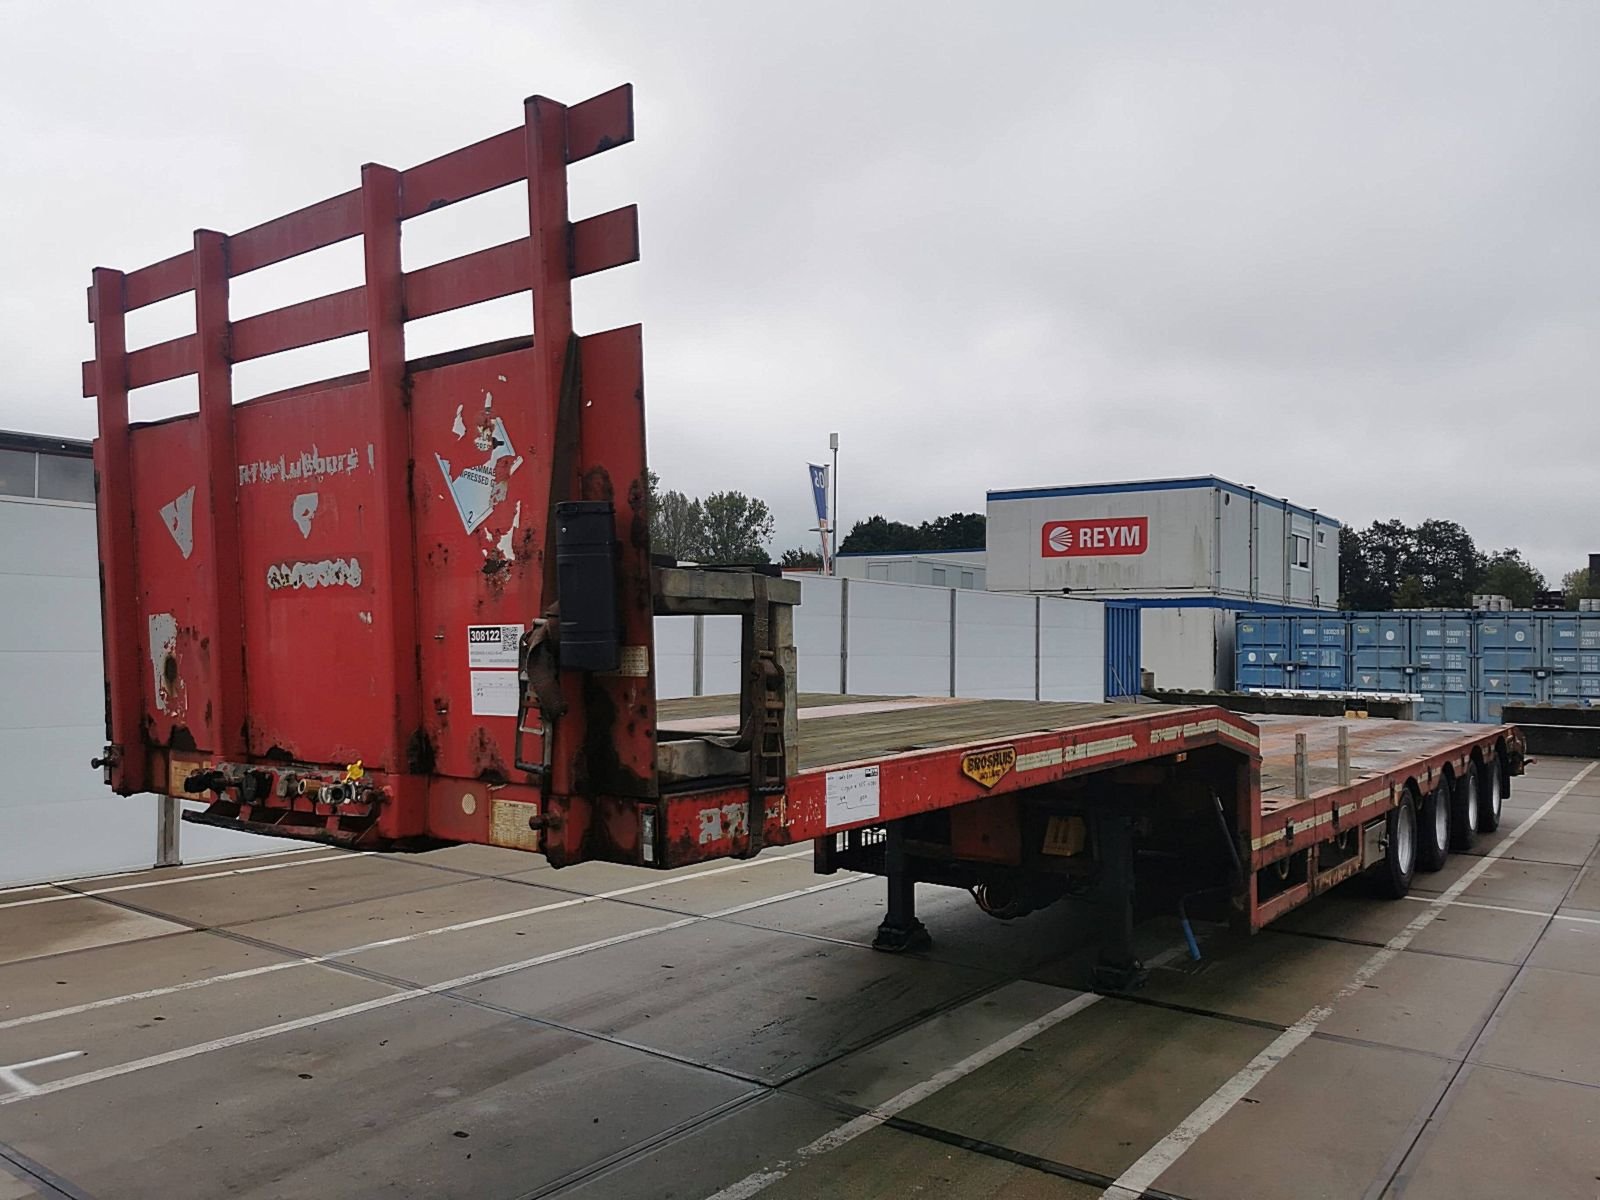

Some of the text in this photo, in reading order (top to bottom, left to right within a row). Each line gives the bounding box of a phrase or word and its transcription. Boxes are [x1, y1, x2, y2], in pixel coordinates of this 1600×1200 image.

[467, 510, 473, 524] 2
[1079, 525, 1140, 548] REYM
[470, 630, 501, 642] 308122
[967, 751, 1014, 774] BROSHUIS
